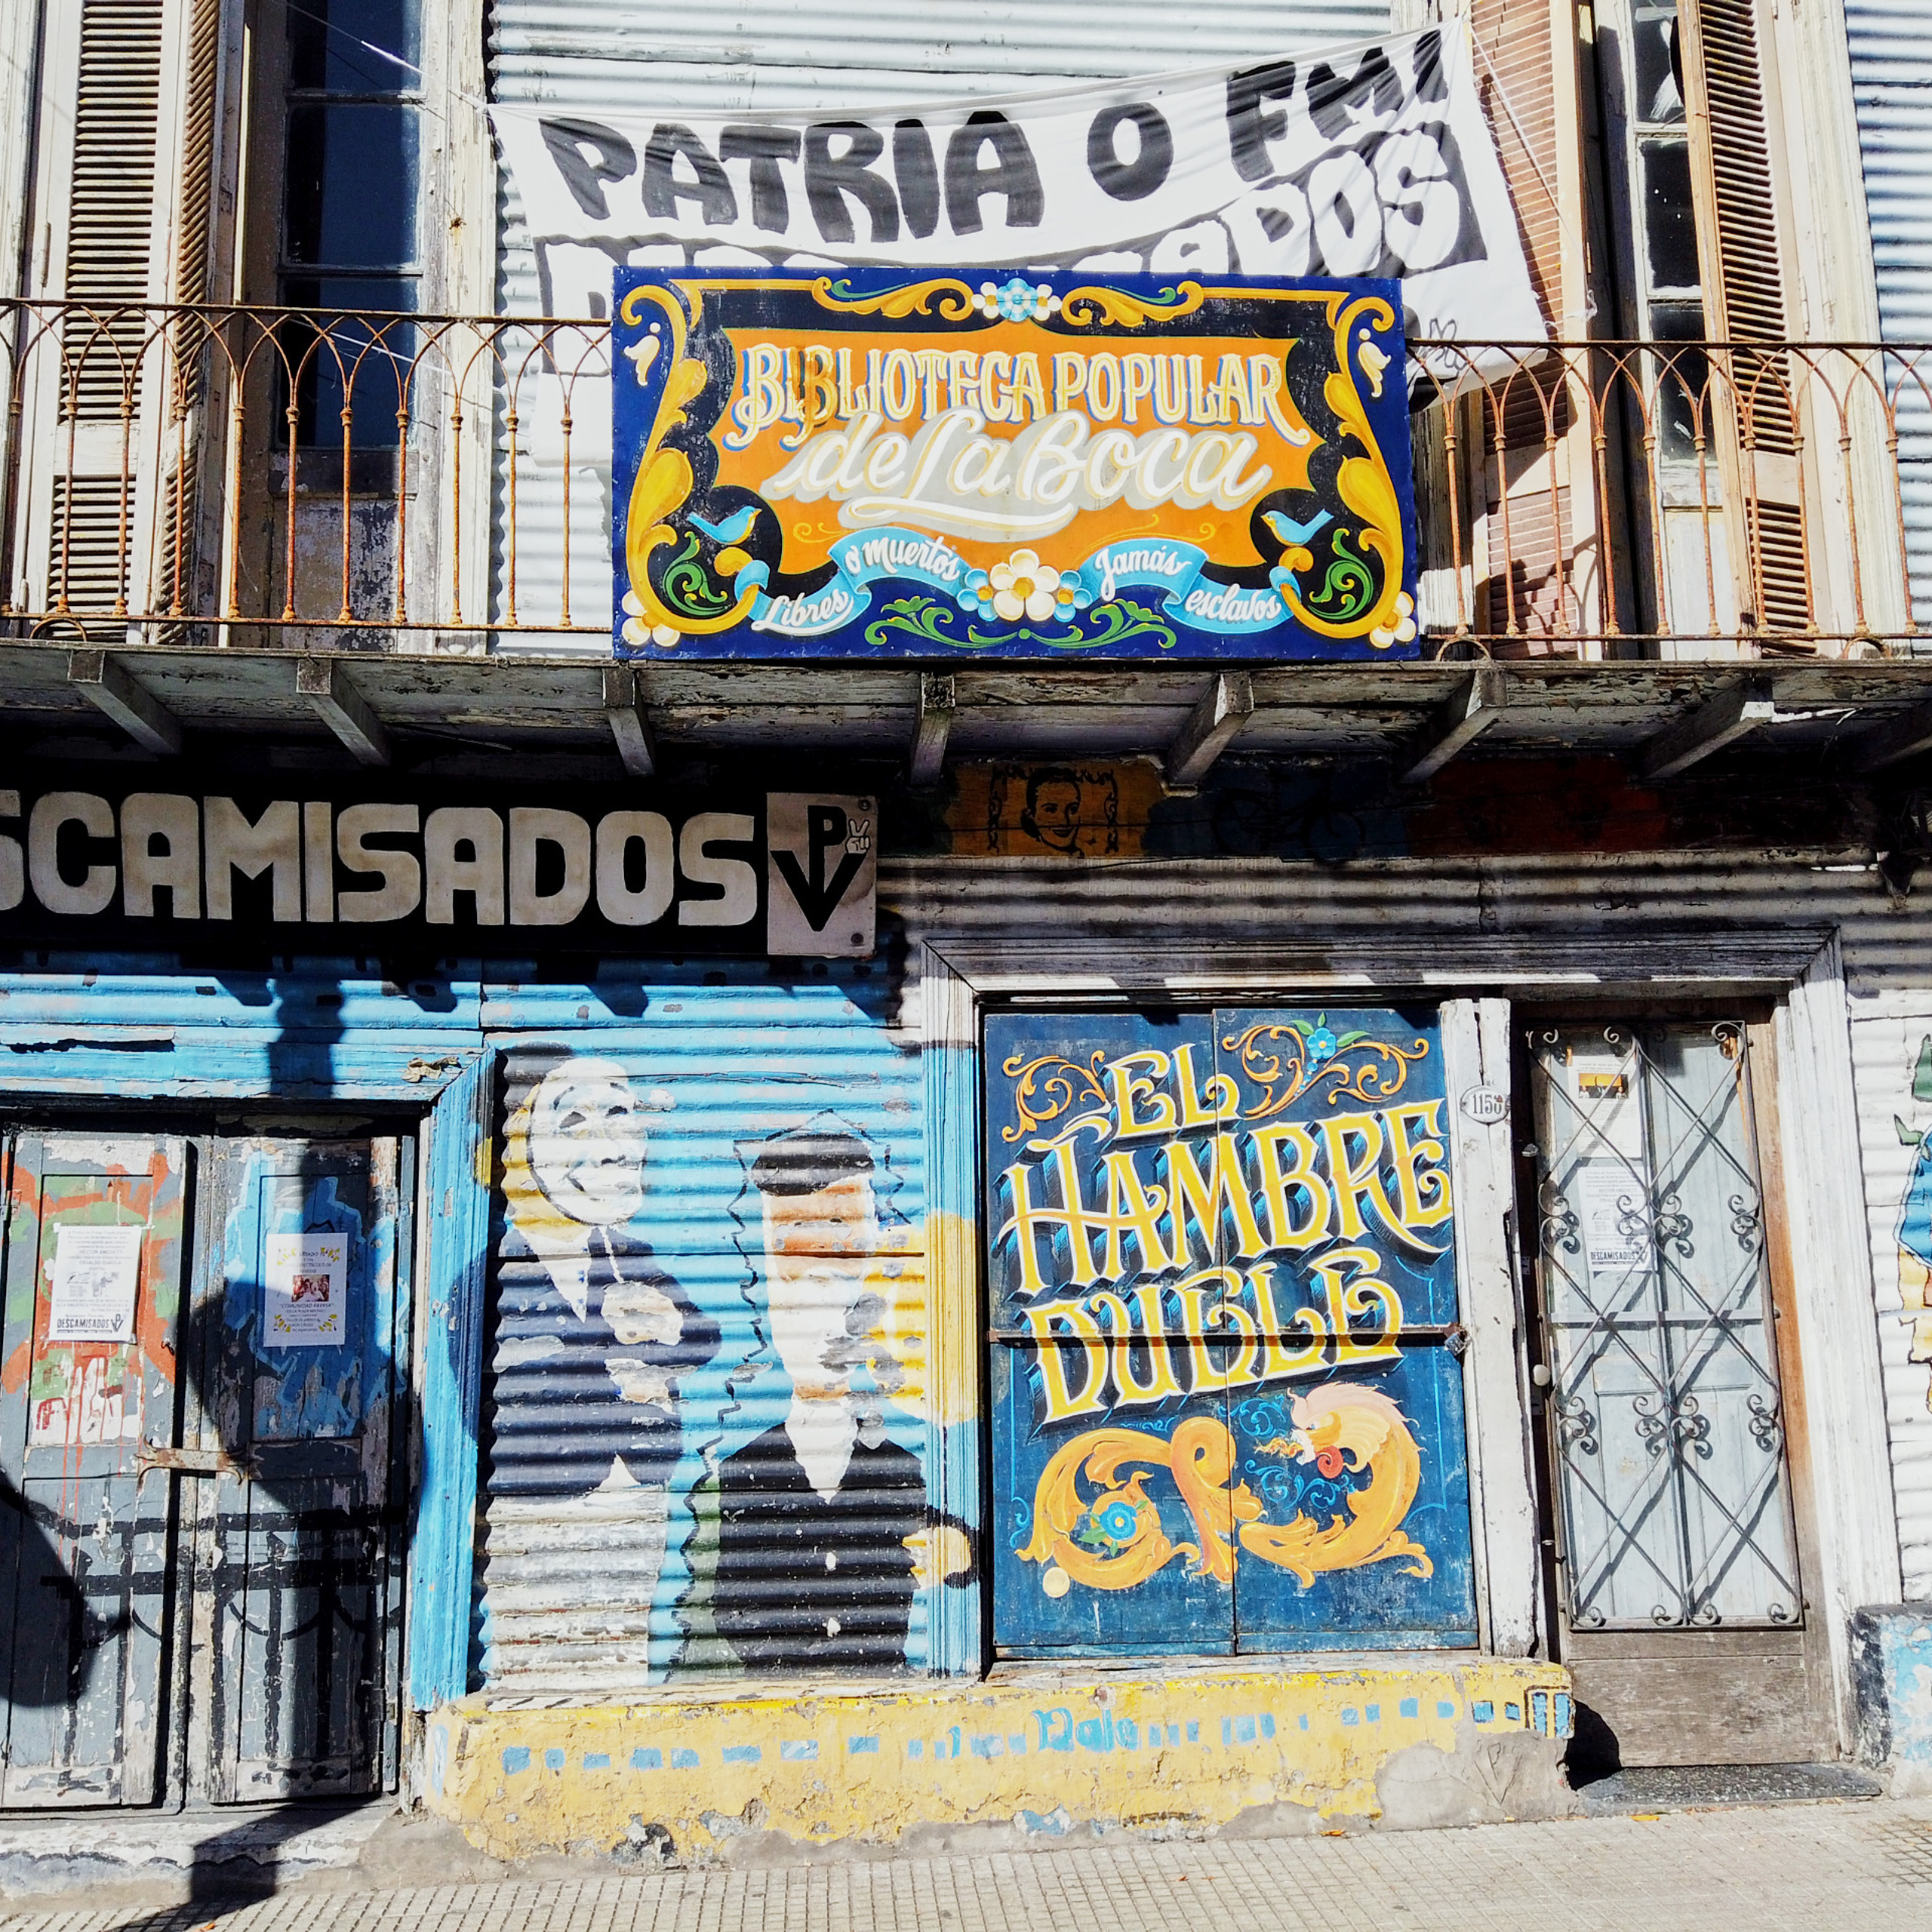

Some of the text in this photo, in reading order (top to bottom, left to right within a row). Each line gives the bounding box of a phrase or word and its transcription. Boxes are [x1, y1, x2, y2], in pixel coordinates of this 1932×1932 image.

[539, 29, 1449, 243] PATRIA O FMI
[722, 343, 1311, 451] BIBLIOTECA POPULAR
[767, 411, 912, 498] de
[1013, 411, 1269, 504] Boca
[751, 589, 854, 637] Libres
[862, 536, 961, 582] Muertos
[1094, 545, 1282, 623] Jamás esclavos
[1105, 1043, 1244, 1139] EL
[995, 1098, 1455, 1297] HAMBRE
[57, 1318, 109, 1328] DESCAMISADOS
[1021, 1248, 1405, 1424] DUELE
